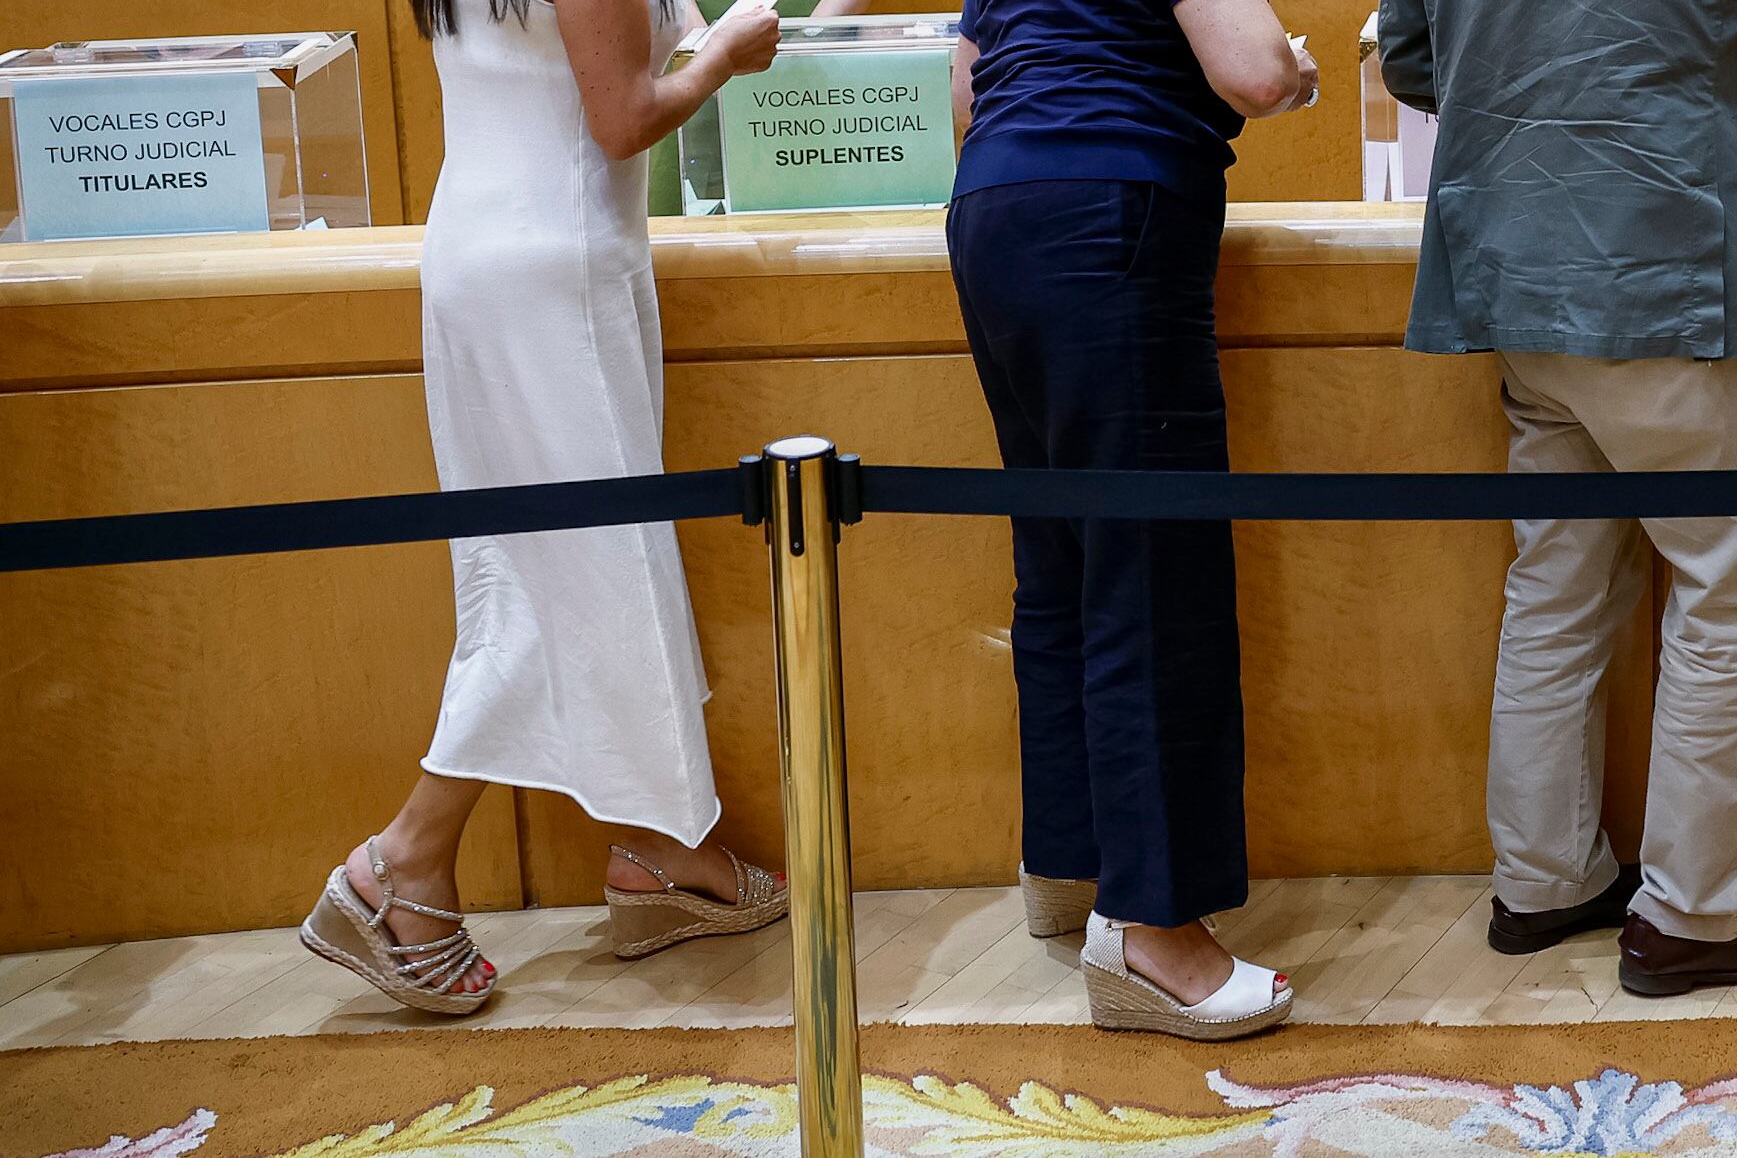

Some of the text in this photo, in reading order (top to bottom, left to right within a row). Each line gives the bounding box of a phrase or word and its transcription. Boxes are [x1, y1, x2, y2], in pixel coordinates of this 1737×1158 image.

[752, 86, 919, 108] VOCALES CGPJ
[48, 109, 226, 133] VOCALES CGPJ
[748, 115, 928, 138] TURNO JUDICIAL
[45, 140, 236, 164] TURNO JUDICIAL
[775, 145, 904, 166] SUPLENTES
[79, 171, 208, 192] TITULARES
